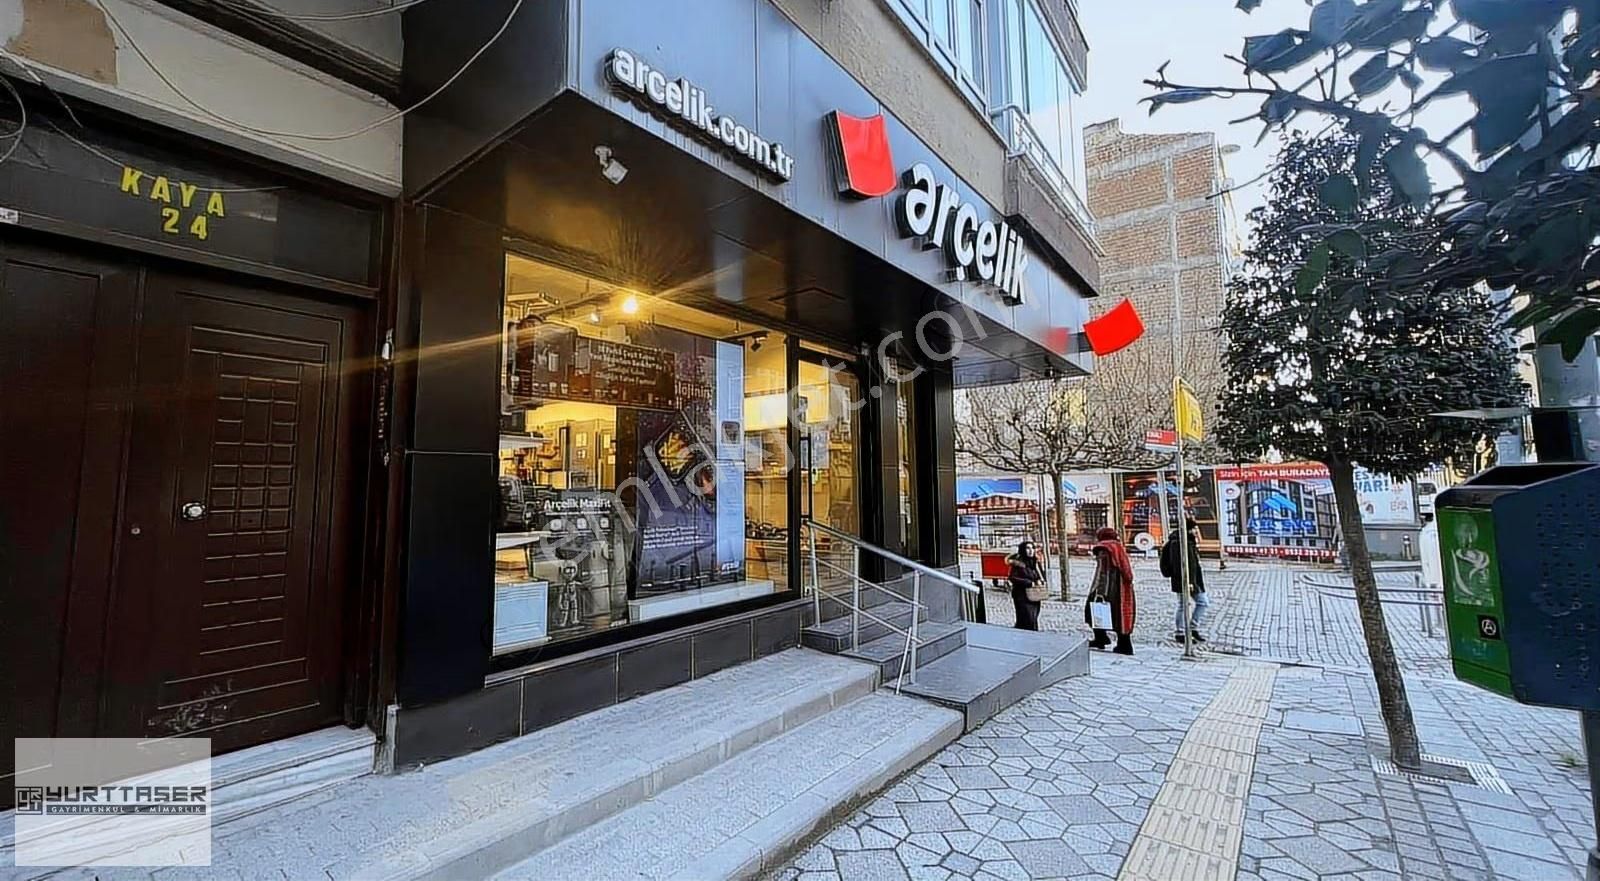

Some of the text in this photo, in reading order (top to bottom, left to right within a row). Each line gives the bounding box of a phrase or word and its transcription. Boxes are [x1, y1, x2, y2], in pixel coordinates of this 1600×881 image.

[609, 46, 794, 180] arcelik.com.tr
[120, 166, 226, 218] KAYA
[162, 207, 208, 240] 24
[903, 162, 1029, 305] arçelik
[1259, 469, 1278, 477] TAM
[1279, 468, 1331, 477] BURADAYI
